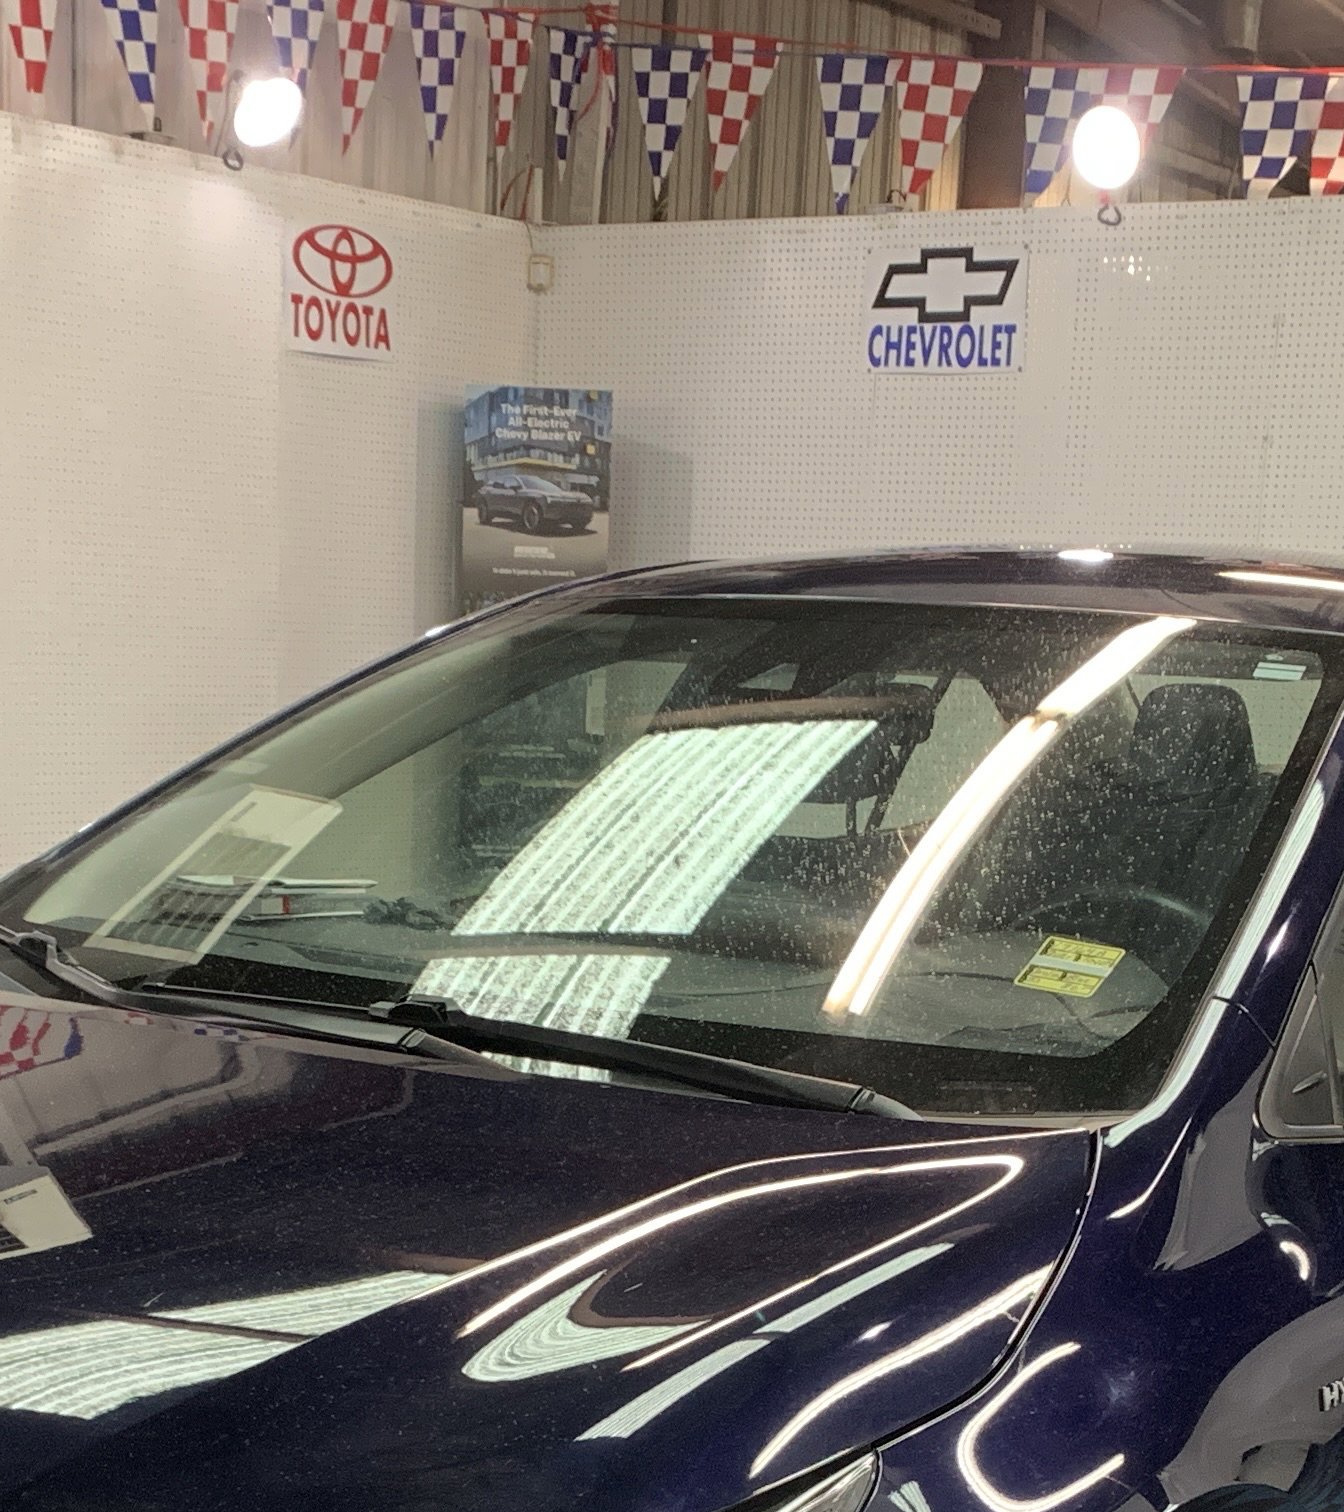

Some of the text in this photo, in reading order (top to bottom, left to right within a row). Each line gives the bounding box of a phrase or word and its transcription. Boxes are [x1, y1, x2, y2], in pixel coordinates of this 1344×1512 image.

[291, 293, 391, 352] TOYOTA
[868, 323, 1017, 368] CHEVROLET
[501, 403, 521, 414] The
[508, 416, 570, 428] All-Electric
[495, 427, 529, 441] Chevy
[567, 430, 582, 441] EV
